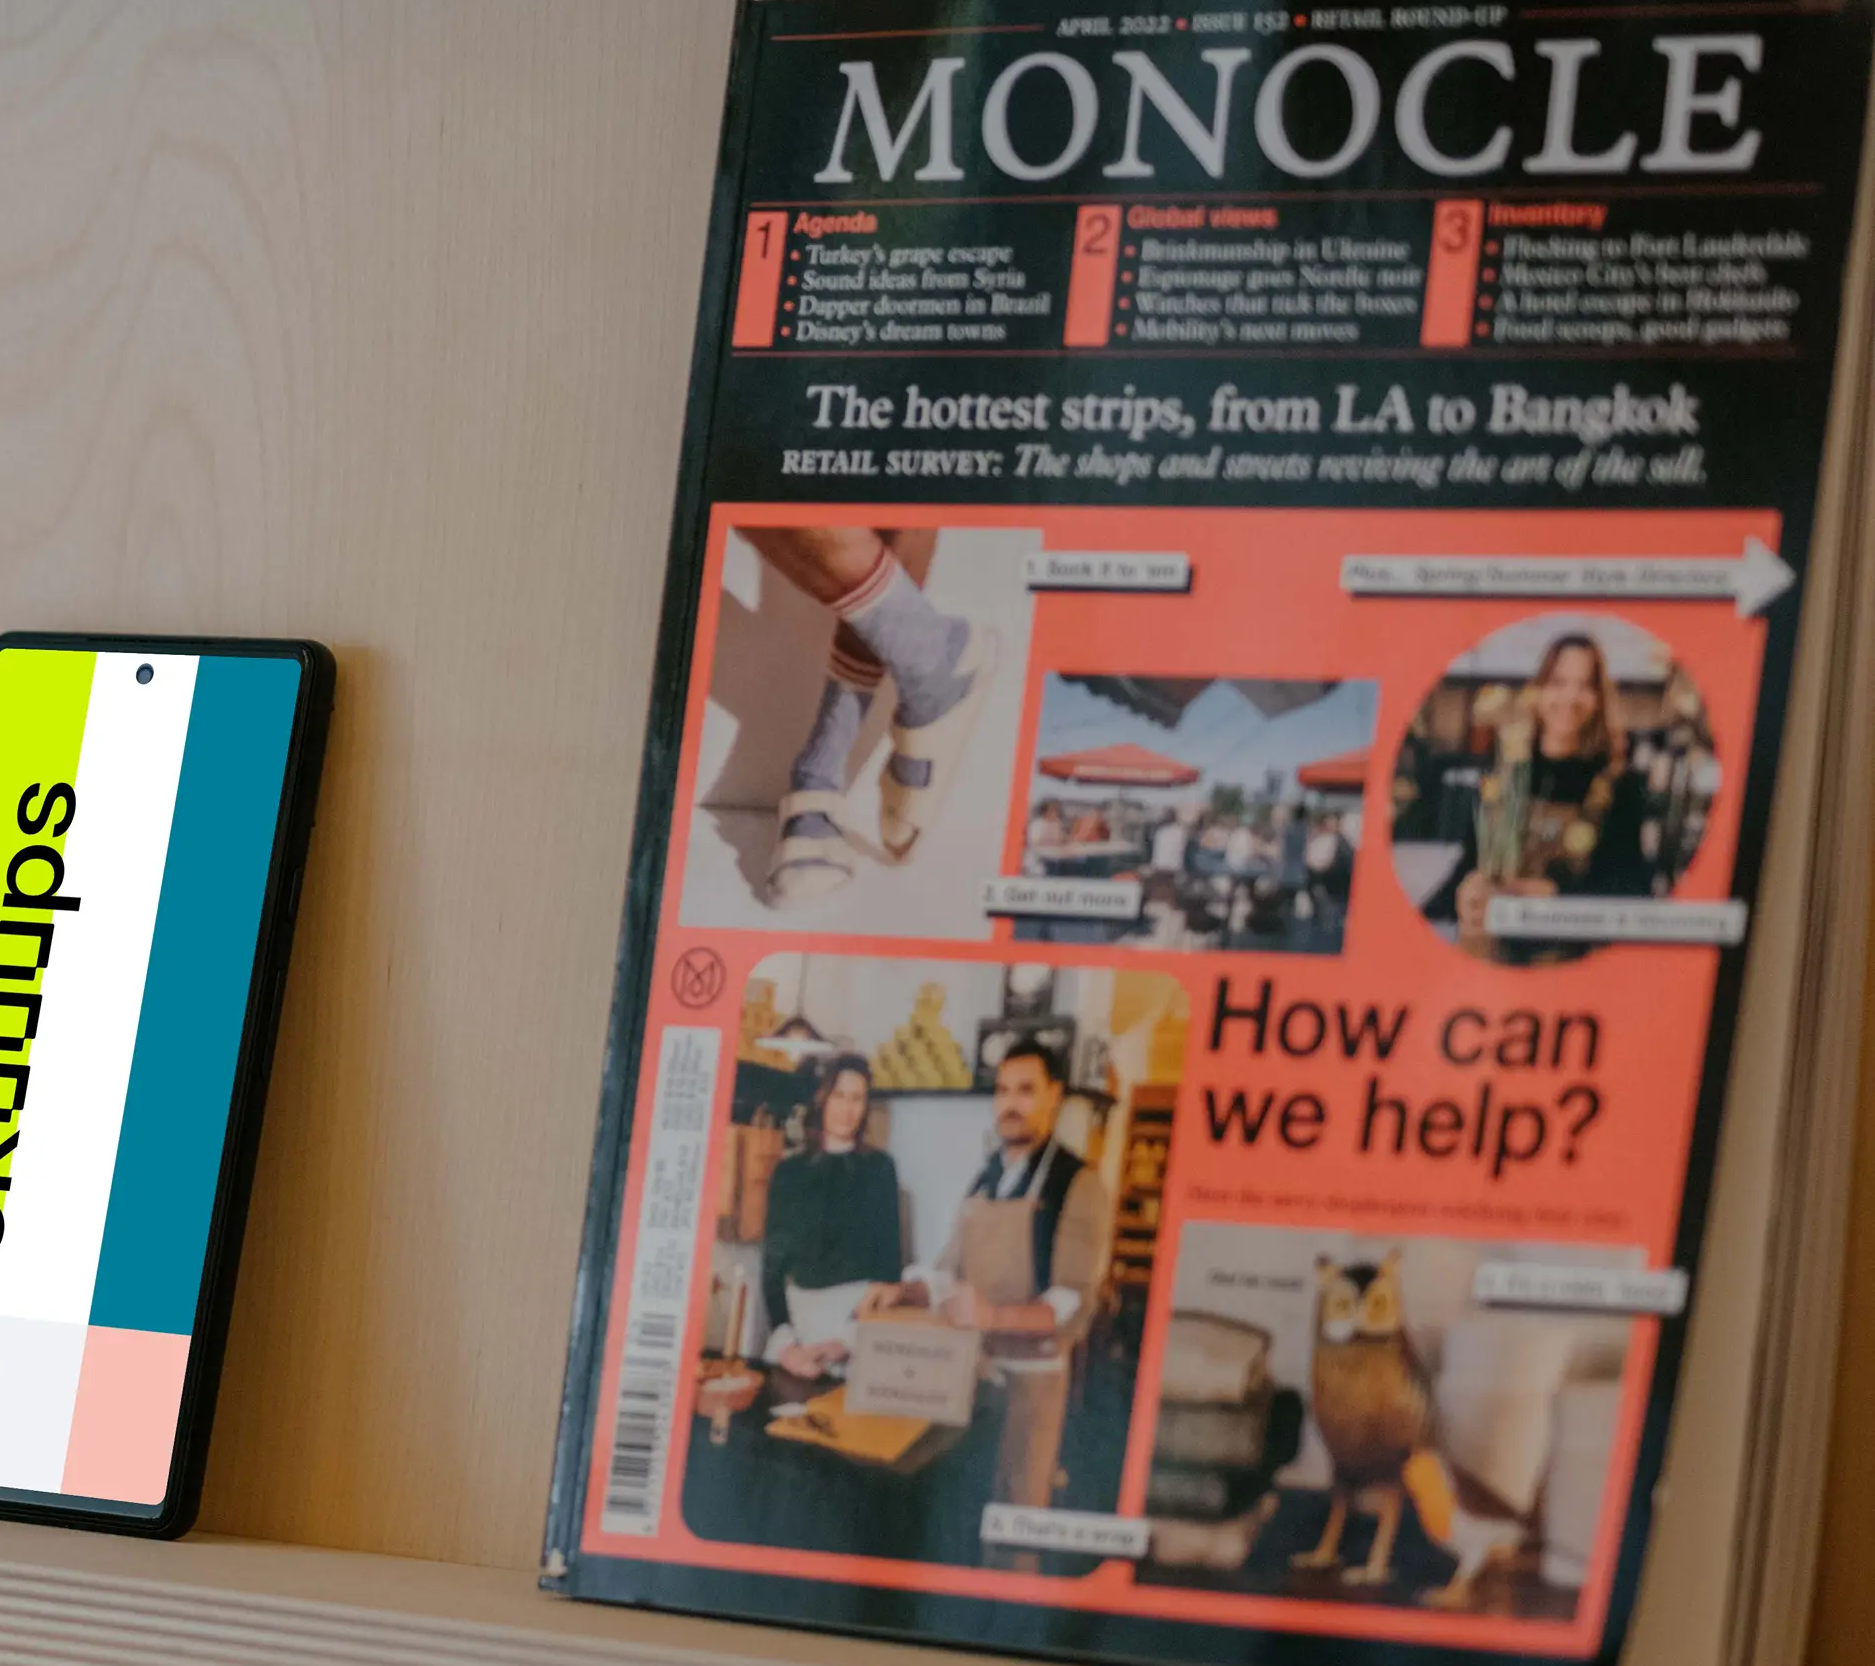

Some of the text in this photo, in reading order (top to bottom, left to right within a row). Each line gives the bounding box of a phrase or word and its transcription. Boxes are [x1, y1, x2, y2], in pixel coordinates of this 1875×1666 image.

[1056, 17, 1114, 37] APRIL
[813, 33, 1765, 183] MONOCLE
[756, 211, 878, 259] 1 Agenda
[1082, 205, 1279, 256] 2 Global views
[1441, 203, 1608, 254] 3 Inventory
[801, 267, 1027, 293] Sound ideas from Syria
[888, 246, 942, 269] grape
[947, 246, 1014, 267] escape
[797, 293, 871, 320] Dapper
[873, 294, 961, 315] doormen
[965, 293, 986, 315] in
[795, 319, 1007, 345] Disney's dream towns
[805, 381, 1701, 446] The hottest strips, from LA to Bangkok
[780, 449, 879, 475] RETAIL
[885, 448, 1004, 476] SURVEY:
[1014, 442, 1071, 477] The
[1073, 443, 1154, 485] shops
[1158, 444, 1222, 480] and
[1208, 975, 1599, 1071] How can
[1202, 1075, 1605, 1182] we help?
